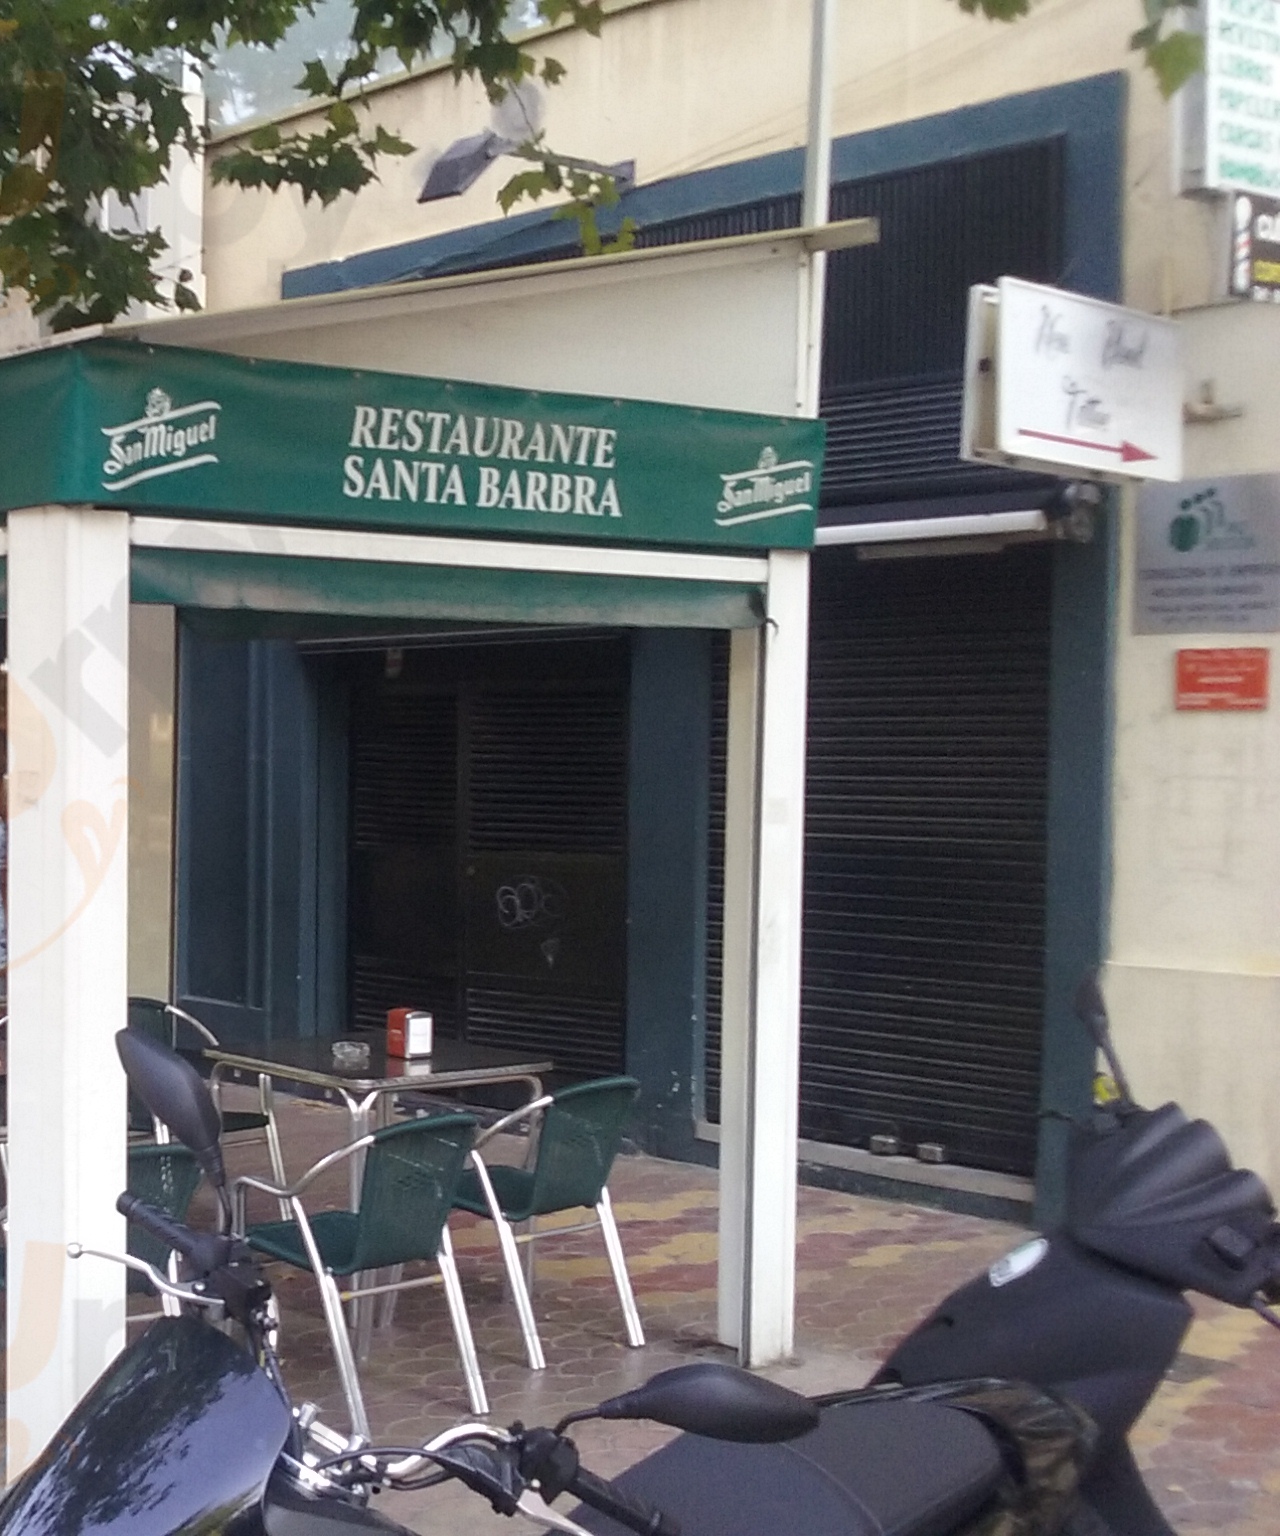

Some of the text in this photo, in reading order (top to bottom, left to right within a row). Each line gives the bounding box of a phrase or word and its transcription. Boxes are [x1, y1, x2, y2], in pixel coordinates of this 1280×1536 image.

[103, 414, 216, 475] San Miguel
[348, 405, 617, 468] RESTAURANTE
[342, 454, 623, 518] SANTA BARBRA
